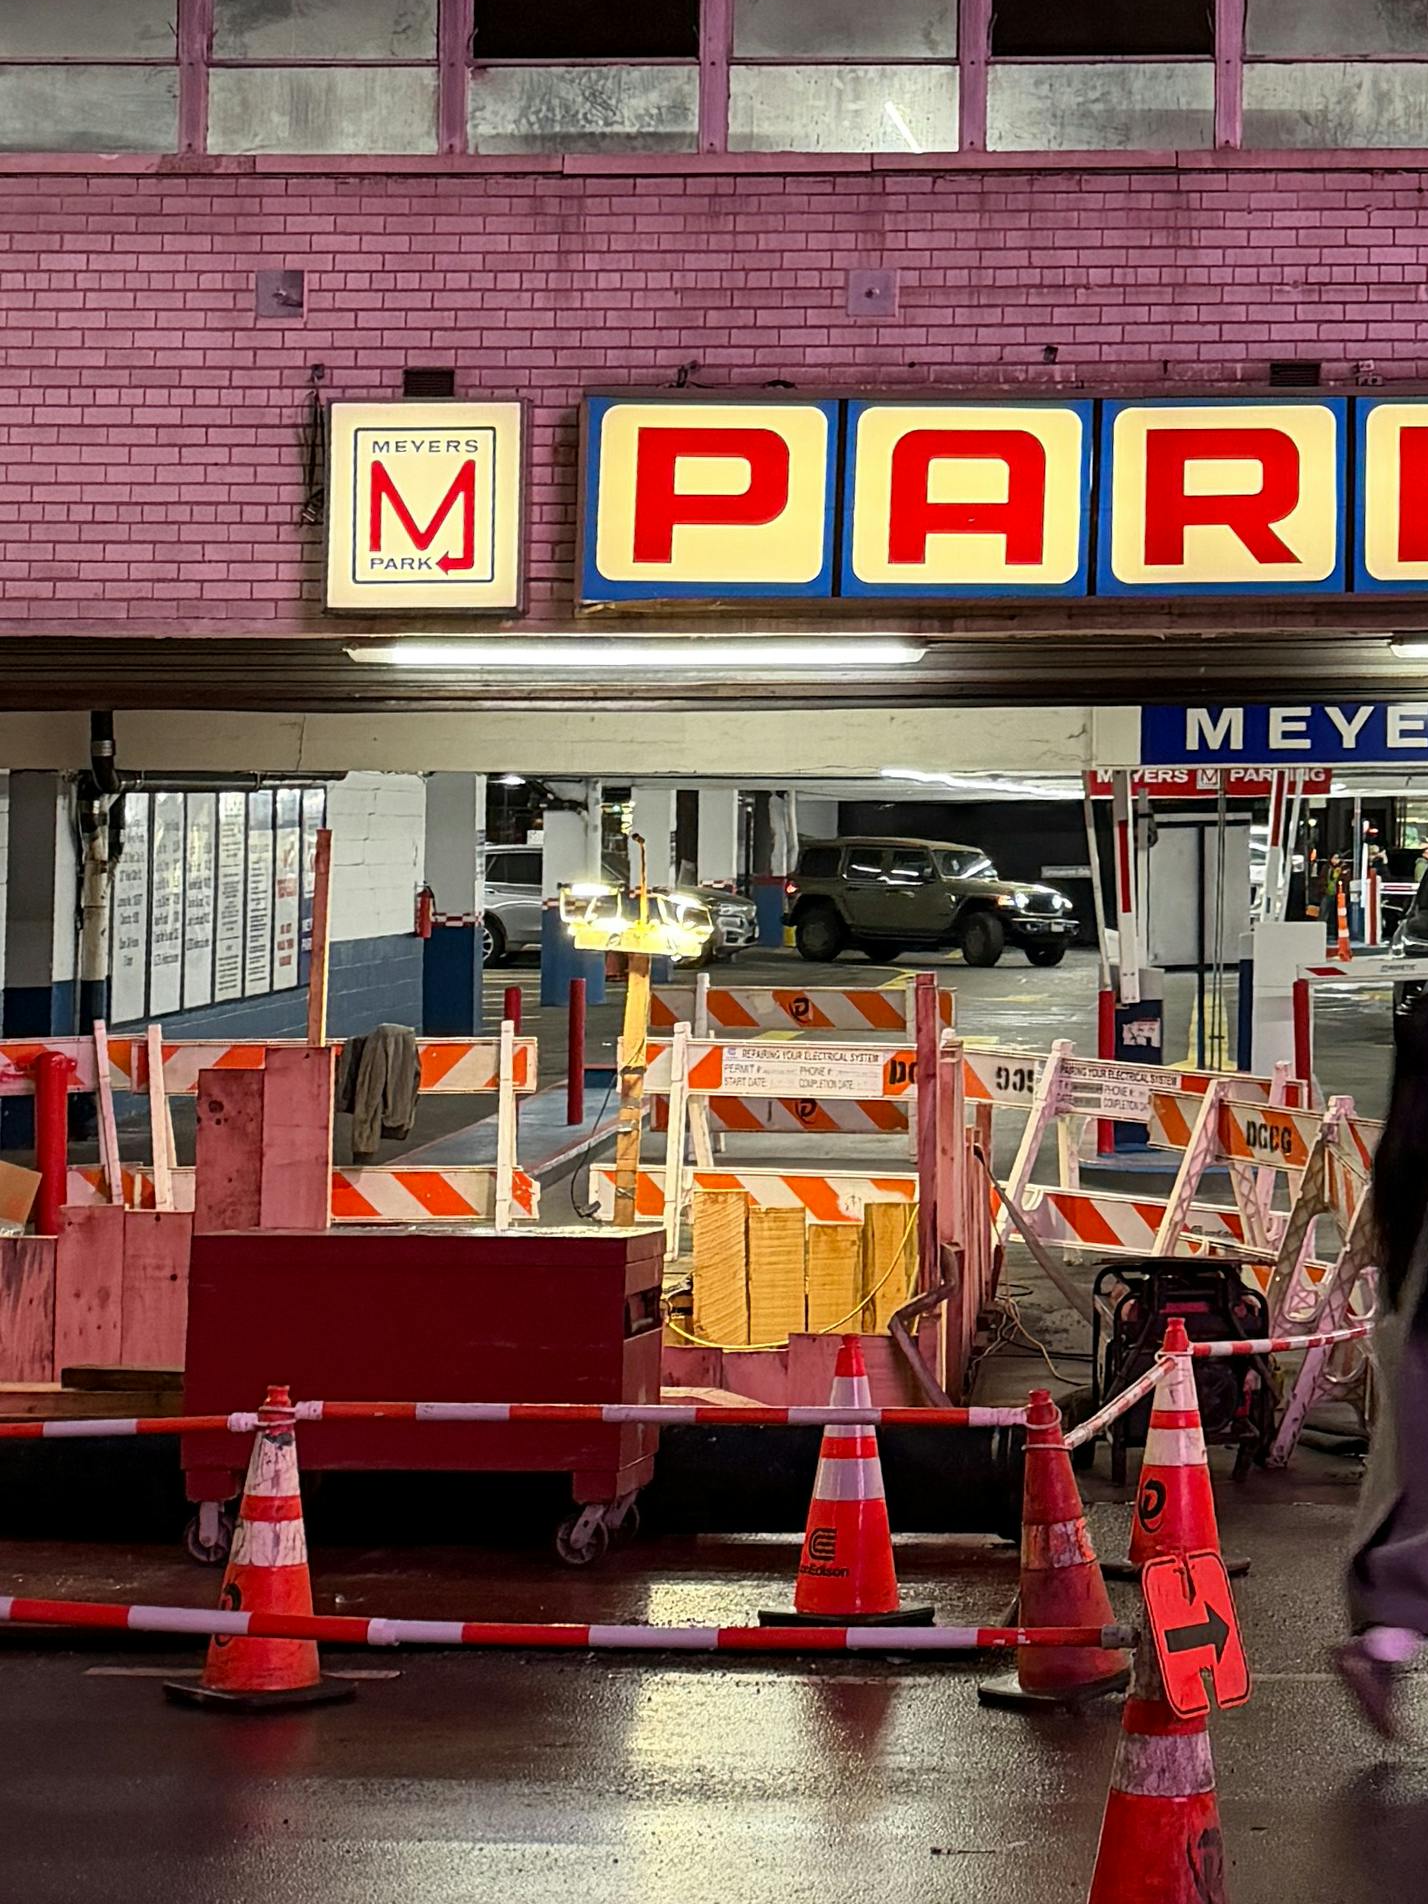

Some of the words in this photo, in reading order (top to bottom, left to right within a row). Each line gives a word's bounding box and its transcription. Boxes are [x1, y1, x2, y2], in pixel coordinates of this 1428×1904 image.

[370, 438, 480, 454] MEYERS
[369, 556, 432, 571] PARK
[1096, 769, 1189, 783] MYERS
[804, 1051, 848, 1061] ELECTRICAL
